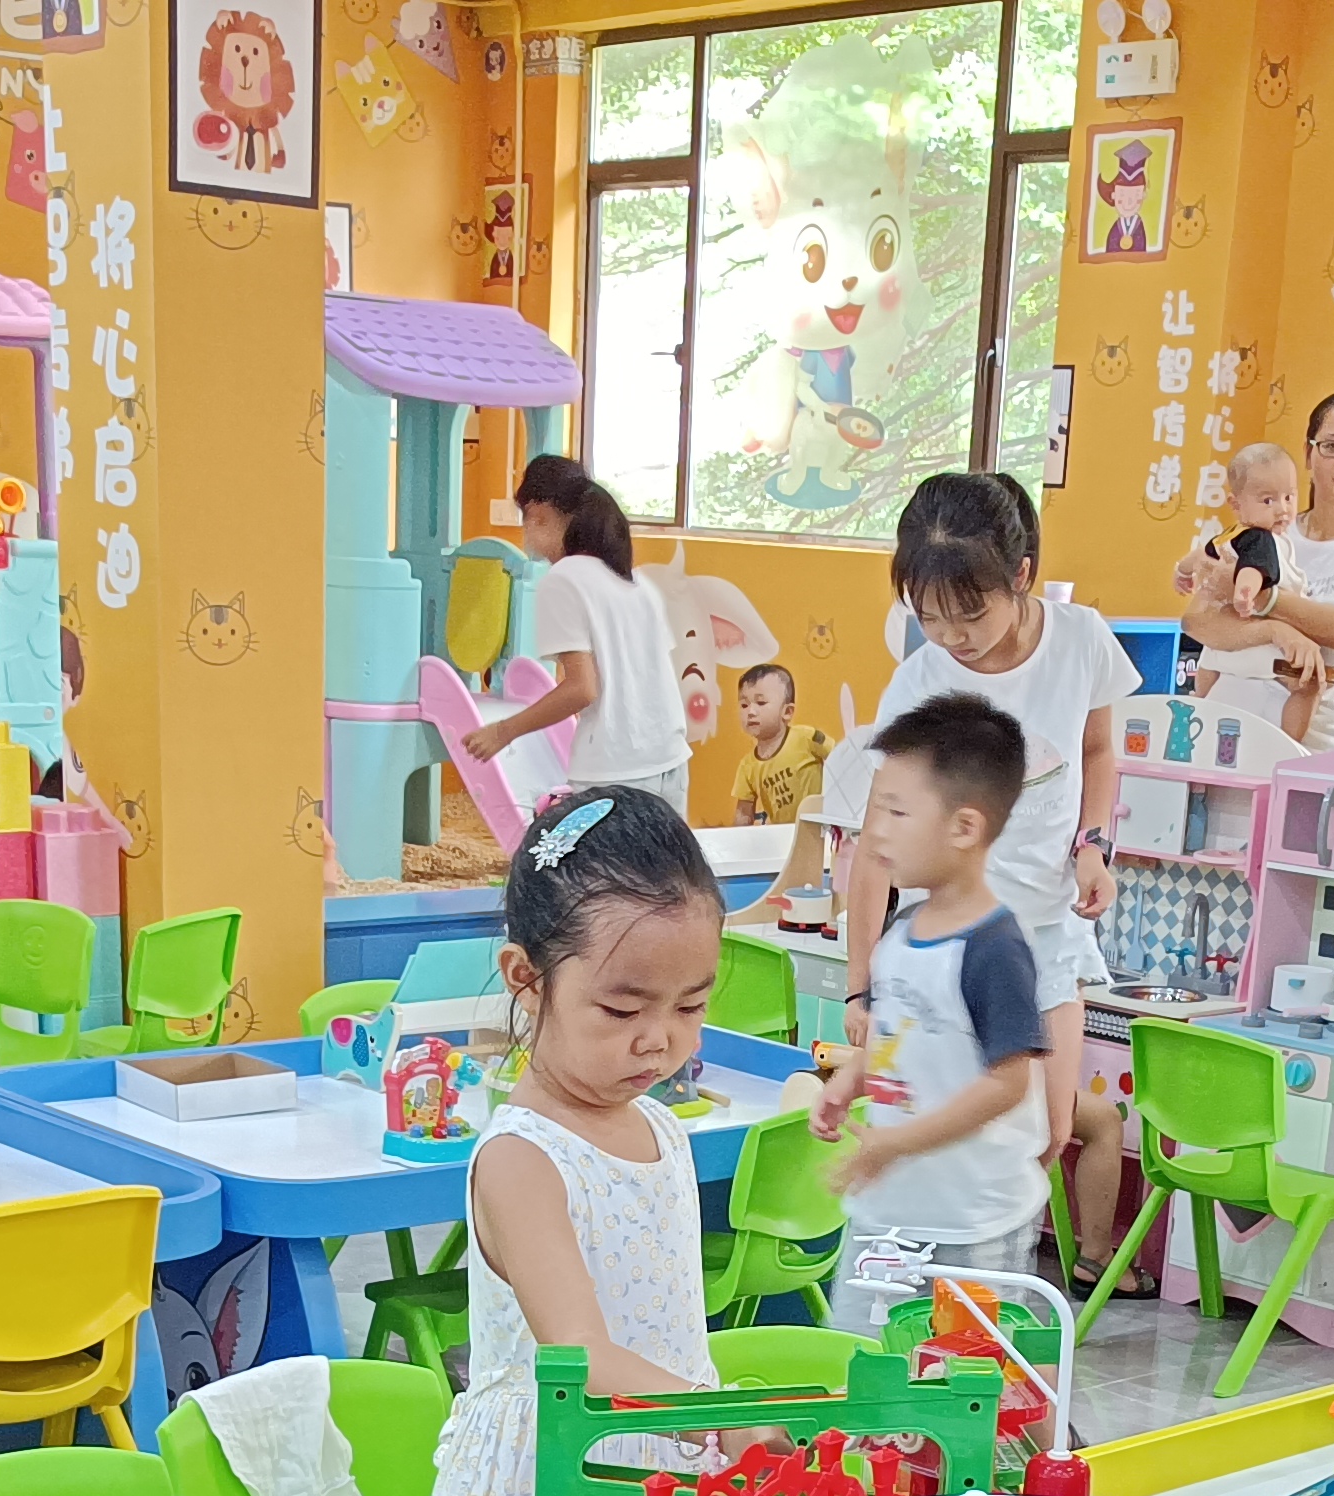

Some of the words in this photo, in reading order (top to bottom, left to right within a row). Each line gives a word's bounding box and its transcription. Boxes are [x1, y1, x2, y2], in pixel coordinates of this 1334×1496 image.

[89, 194, 142, 610] 将心启迪
[1145, 289, 1195, 503] 让智传递
[763, 767, 793, 789] SKATE
[774, 782, 790, 796] ALL
[776, 793, 794, 809] DAY
